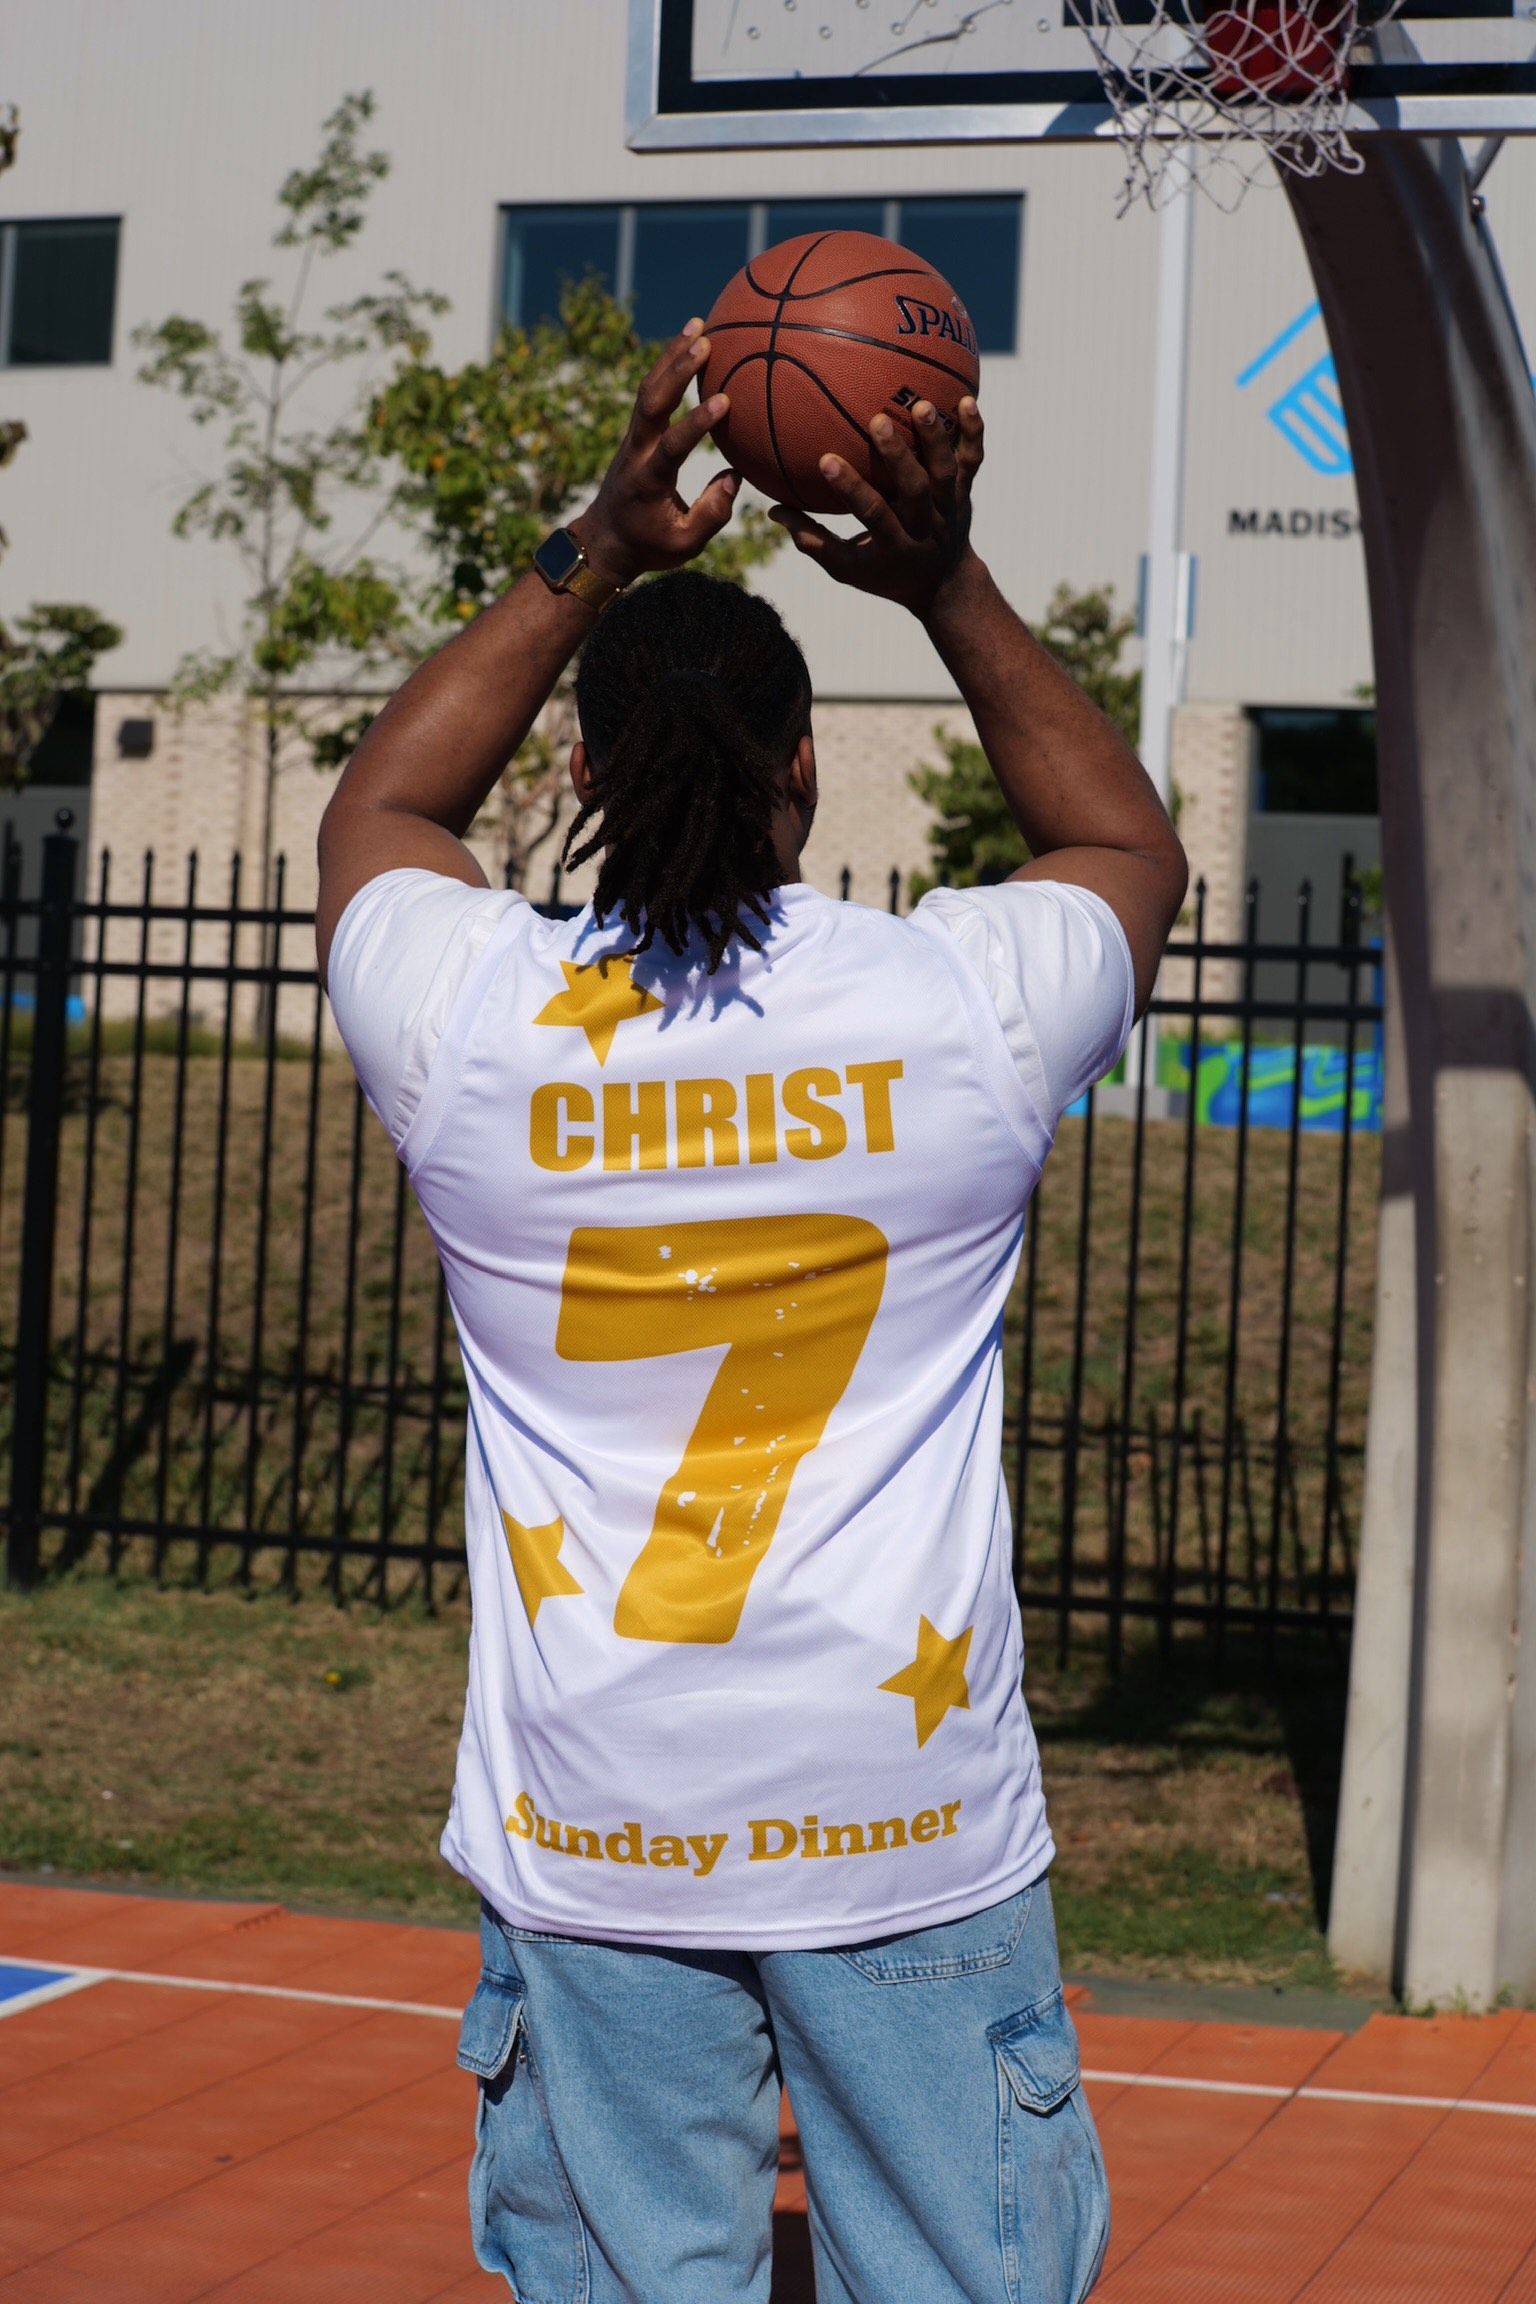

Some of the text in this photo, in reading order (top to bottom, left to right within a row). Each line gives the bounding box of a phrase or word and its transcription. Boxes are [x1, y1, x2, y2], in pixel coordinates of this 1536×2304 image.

[1229, 510, 1361, 538] MADIS
[529, 1060, 904, 1172] CHRIST
[555, 1213, 890, 1645] 7
[505, 1791, 961, 1876] Sunday Dinner
